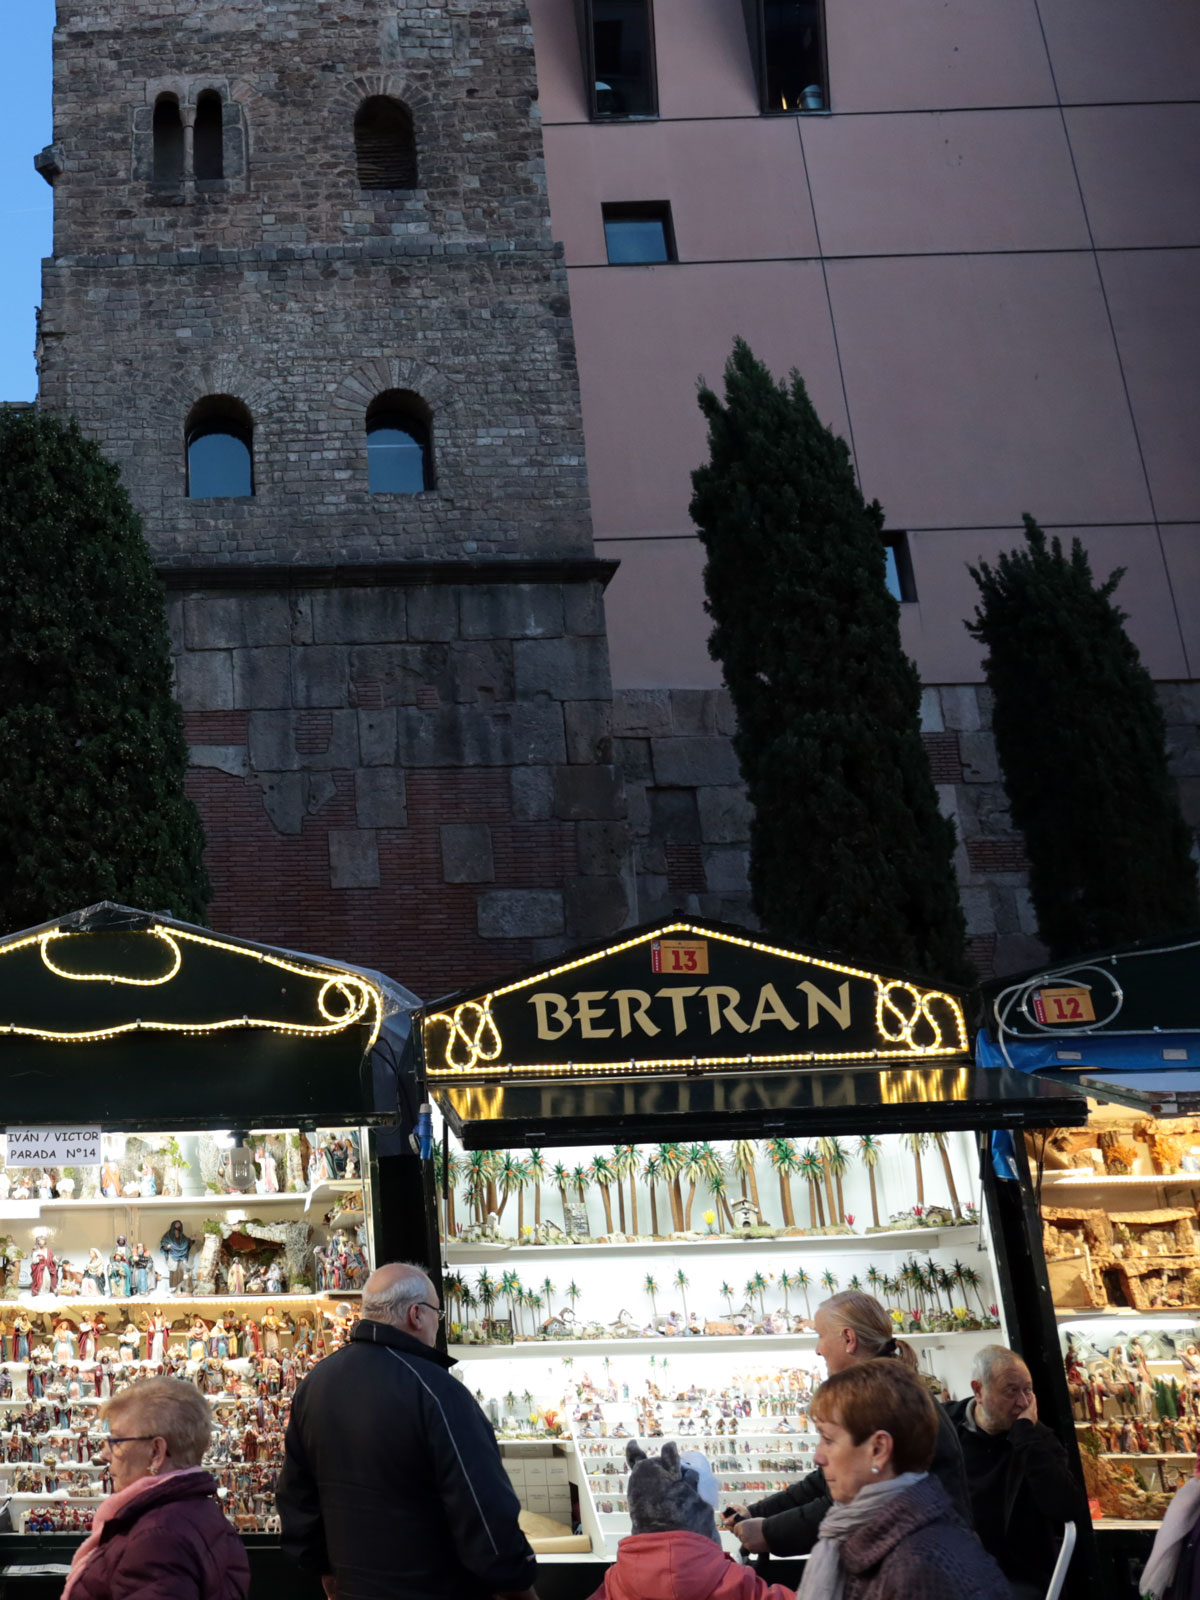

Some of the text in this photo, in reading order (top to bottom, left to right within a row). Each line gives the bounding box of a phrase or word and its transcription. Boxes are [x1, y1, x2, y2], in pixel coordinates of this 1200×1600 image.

[671, 950, 698, 971] 13
[527, 981, 851, 1040] BERTRAN
[1053, 997, 1083, 1019] 12
[8, 1130, 40, 1143] IVÁN
[54, 1131, 99, 1142] VICTOR
[10, 1149, 57, 1159] PARADA
